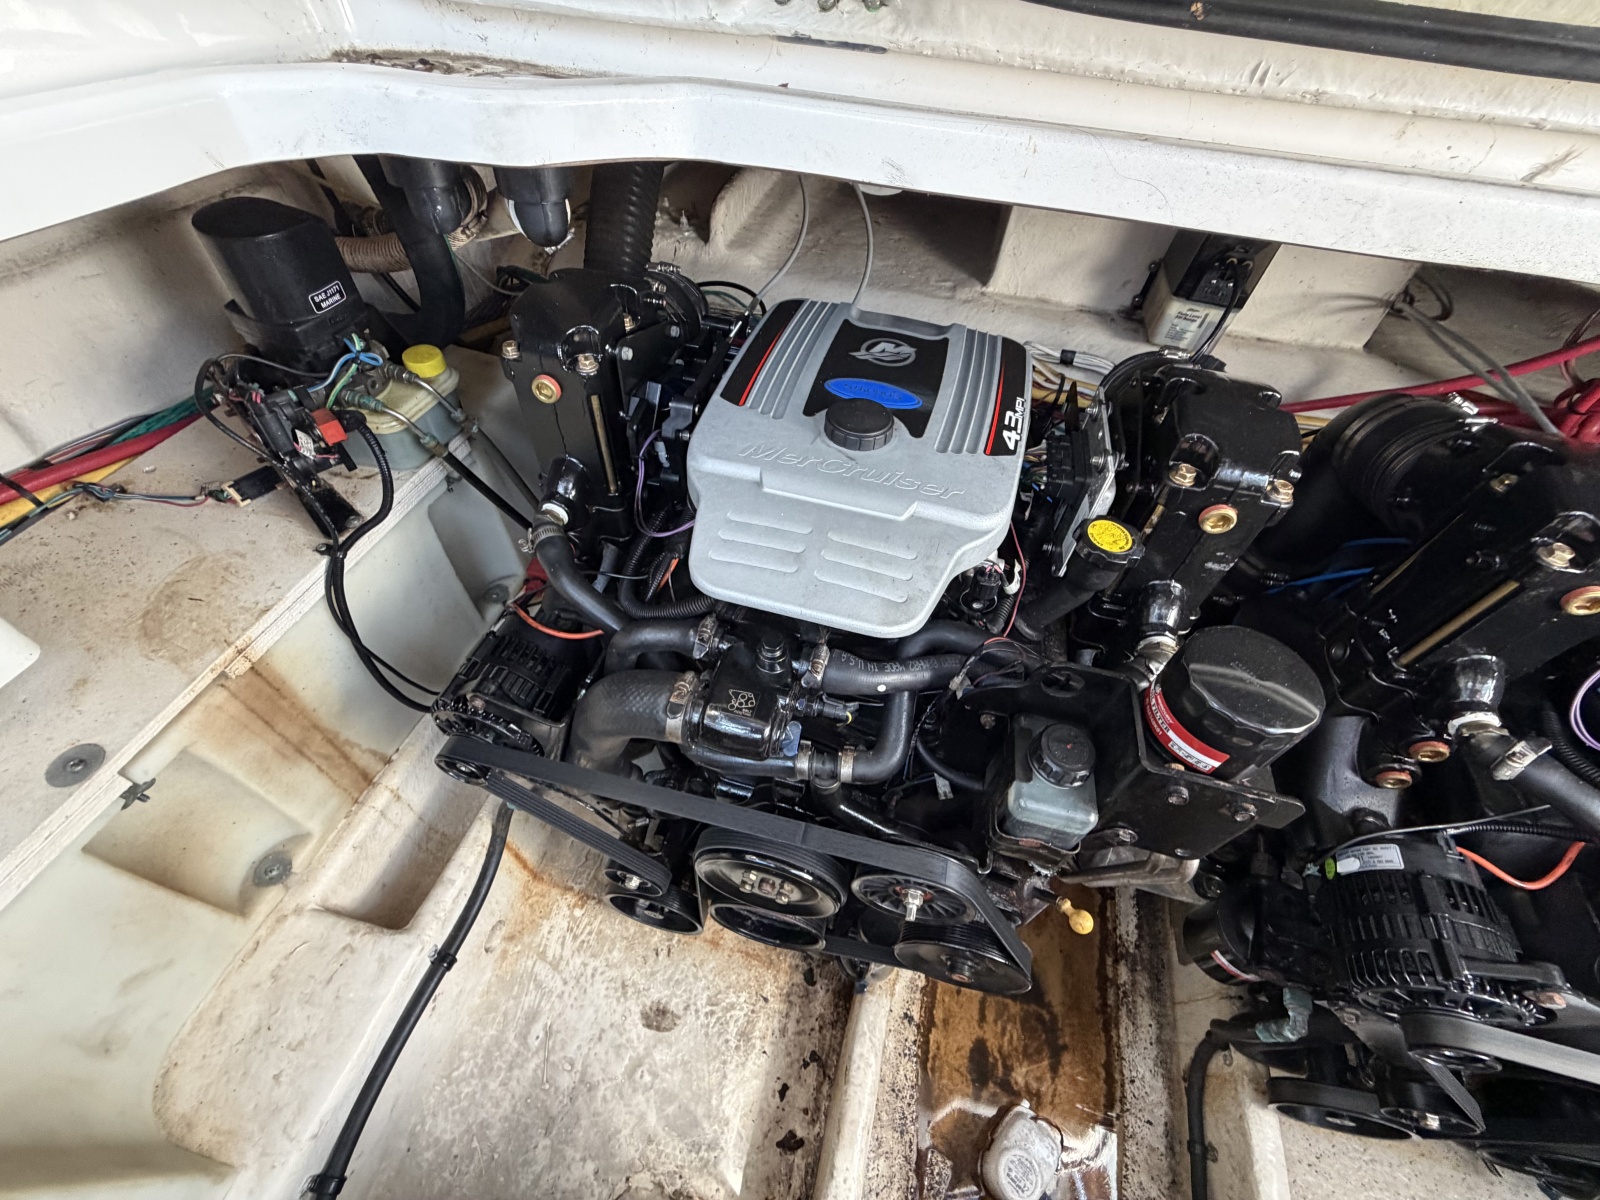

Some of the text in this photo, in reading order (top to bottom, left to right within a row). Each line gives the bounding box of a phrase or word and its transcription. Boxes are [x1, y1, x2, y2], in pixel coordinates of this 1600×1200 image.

[314, 284, 340, 303] SAE J1171
[320, 293, 341, 309] MARINE
[738, 443, 965, 500] MerCruiser
[867, 661, 879, 672] IN
[1152, 702, 1170, 733] FILTER
